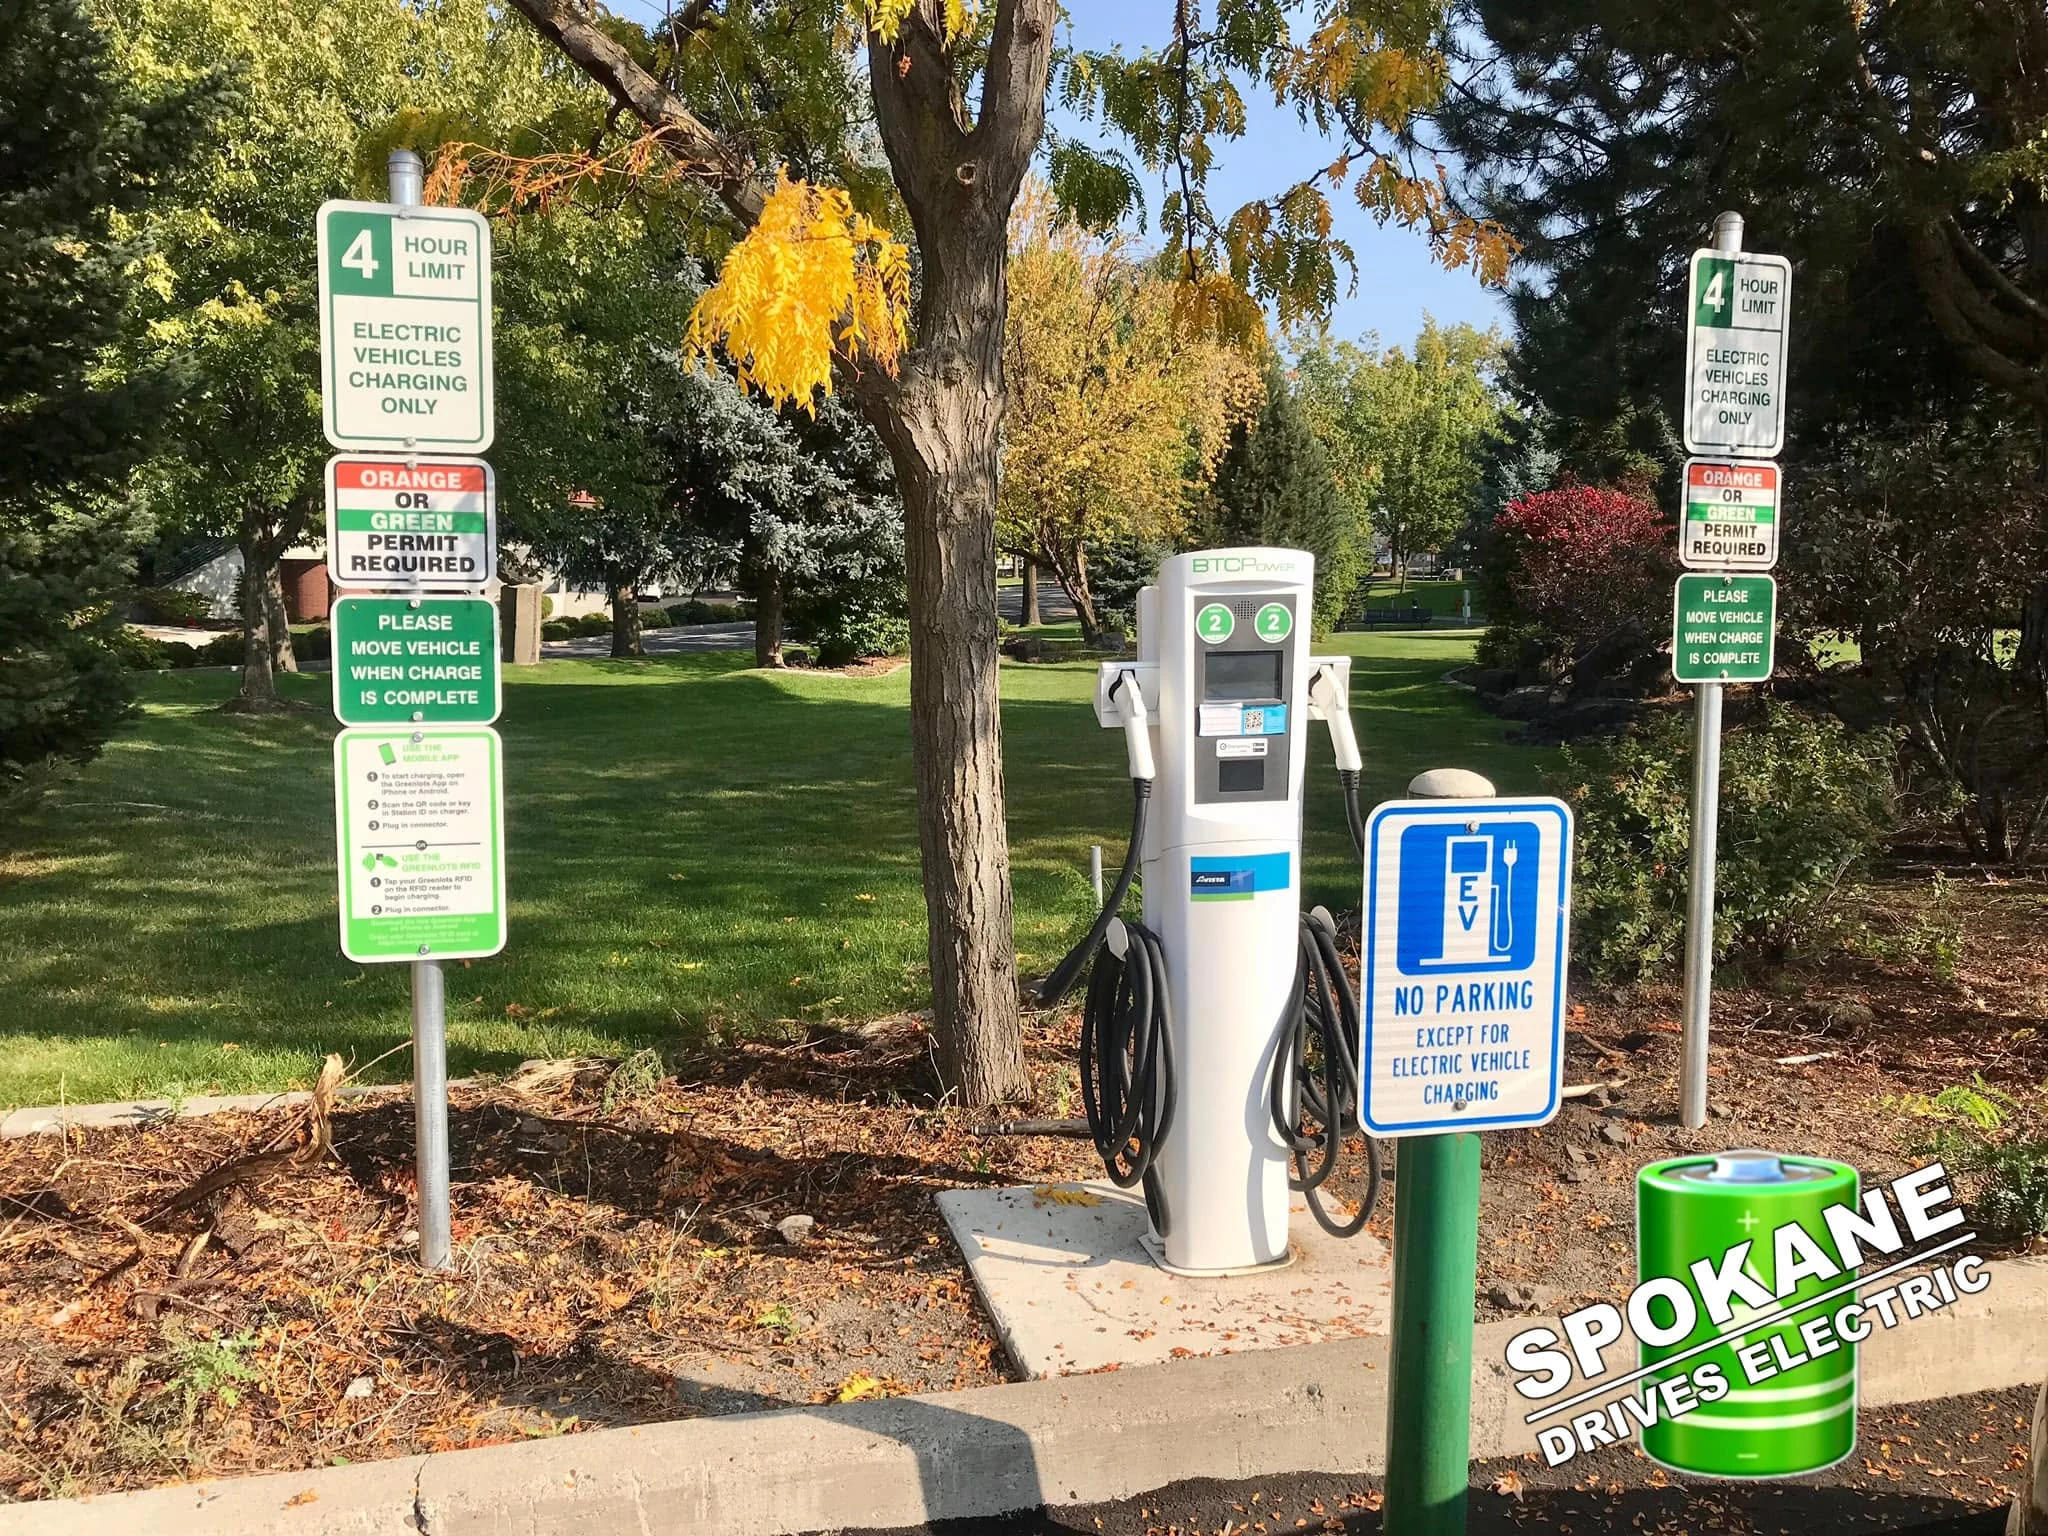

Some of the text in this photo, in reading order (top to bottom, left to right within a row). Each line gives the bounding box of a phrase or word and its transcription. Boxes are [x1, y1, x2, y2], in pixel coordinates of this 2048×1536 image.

[341, 229, 379, 279] 4
[405, 236, 468, 256] HOUR
[409, 262, 465, 280] LIMIT
[1702, 272, 1725, 313] 4
[1741, 278, 1778, 295] HOUR
[1742, 300, 1776, 314] LIMIT
[353, 322, 461, 343] ELECTRIC
[353, 347, 461, 367] VEHICLES
[1706, 349, 1769, 366] ELECTRIC
[349, 372, 468, 392] CHARGING
[1705, 370, 1768, 386] VEHICLES
[381, 398, 438, 415] ONLY
[1701, 390, 1770, 406] CHARGING
[1719, 411, 1752, 424] ONLY
[360, 469, 462, 489] ORANGE
[1703, 470, 1762, 487] ORANGE
[395, 493, 429, 509] OR
[1722, 489, 1742, 502] OR
[371, 513, 453, 531] GREEN
[1708, 506, 1756, 521] GREEN
[1704, 524, 1757, 539] PERMIT
[368, 534, 458, 551] PERMIT
[1693, 541, 1766, 555] REQUIRED
[351, 556, 475, 573] REQUIRED
[1703, 590, 1748, 603] PLEASE
[378, 615, 453, 631] PLEASE
[1209, 615, 1221, 632] 2
[1267, 614, 1279, 631] 2
[1686, 611, 1764, 624] MOVE VEHICLE
[1685, 632, 1763, 644] WHEN CHARGE
[351, 641, 480, 656] MOVE VEHICLE
[1689, 653, 1760, 664] IS COMPLETE
[350, 666, 482, 680] WHEN CHARGE
[361, 691, 479, 705] IS COMPLETE
[402, 862, 481, 871] GREENLOTS RFID
[418, 876, 453, 884] Greenlots
[385, 893, 405, 901] begin
[1395, 980, 1533, 1016] NO PARKING
[1416, 1024, 1509, 1048] EXCEPT FOR
[1393, 1050, 1530, 1077] ELECTRIC VEHICLE
[1424, 1081, 1498, 1104] CHARGING
